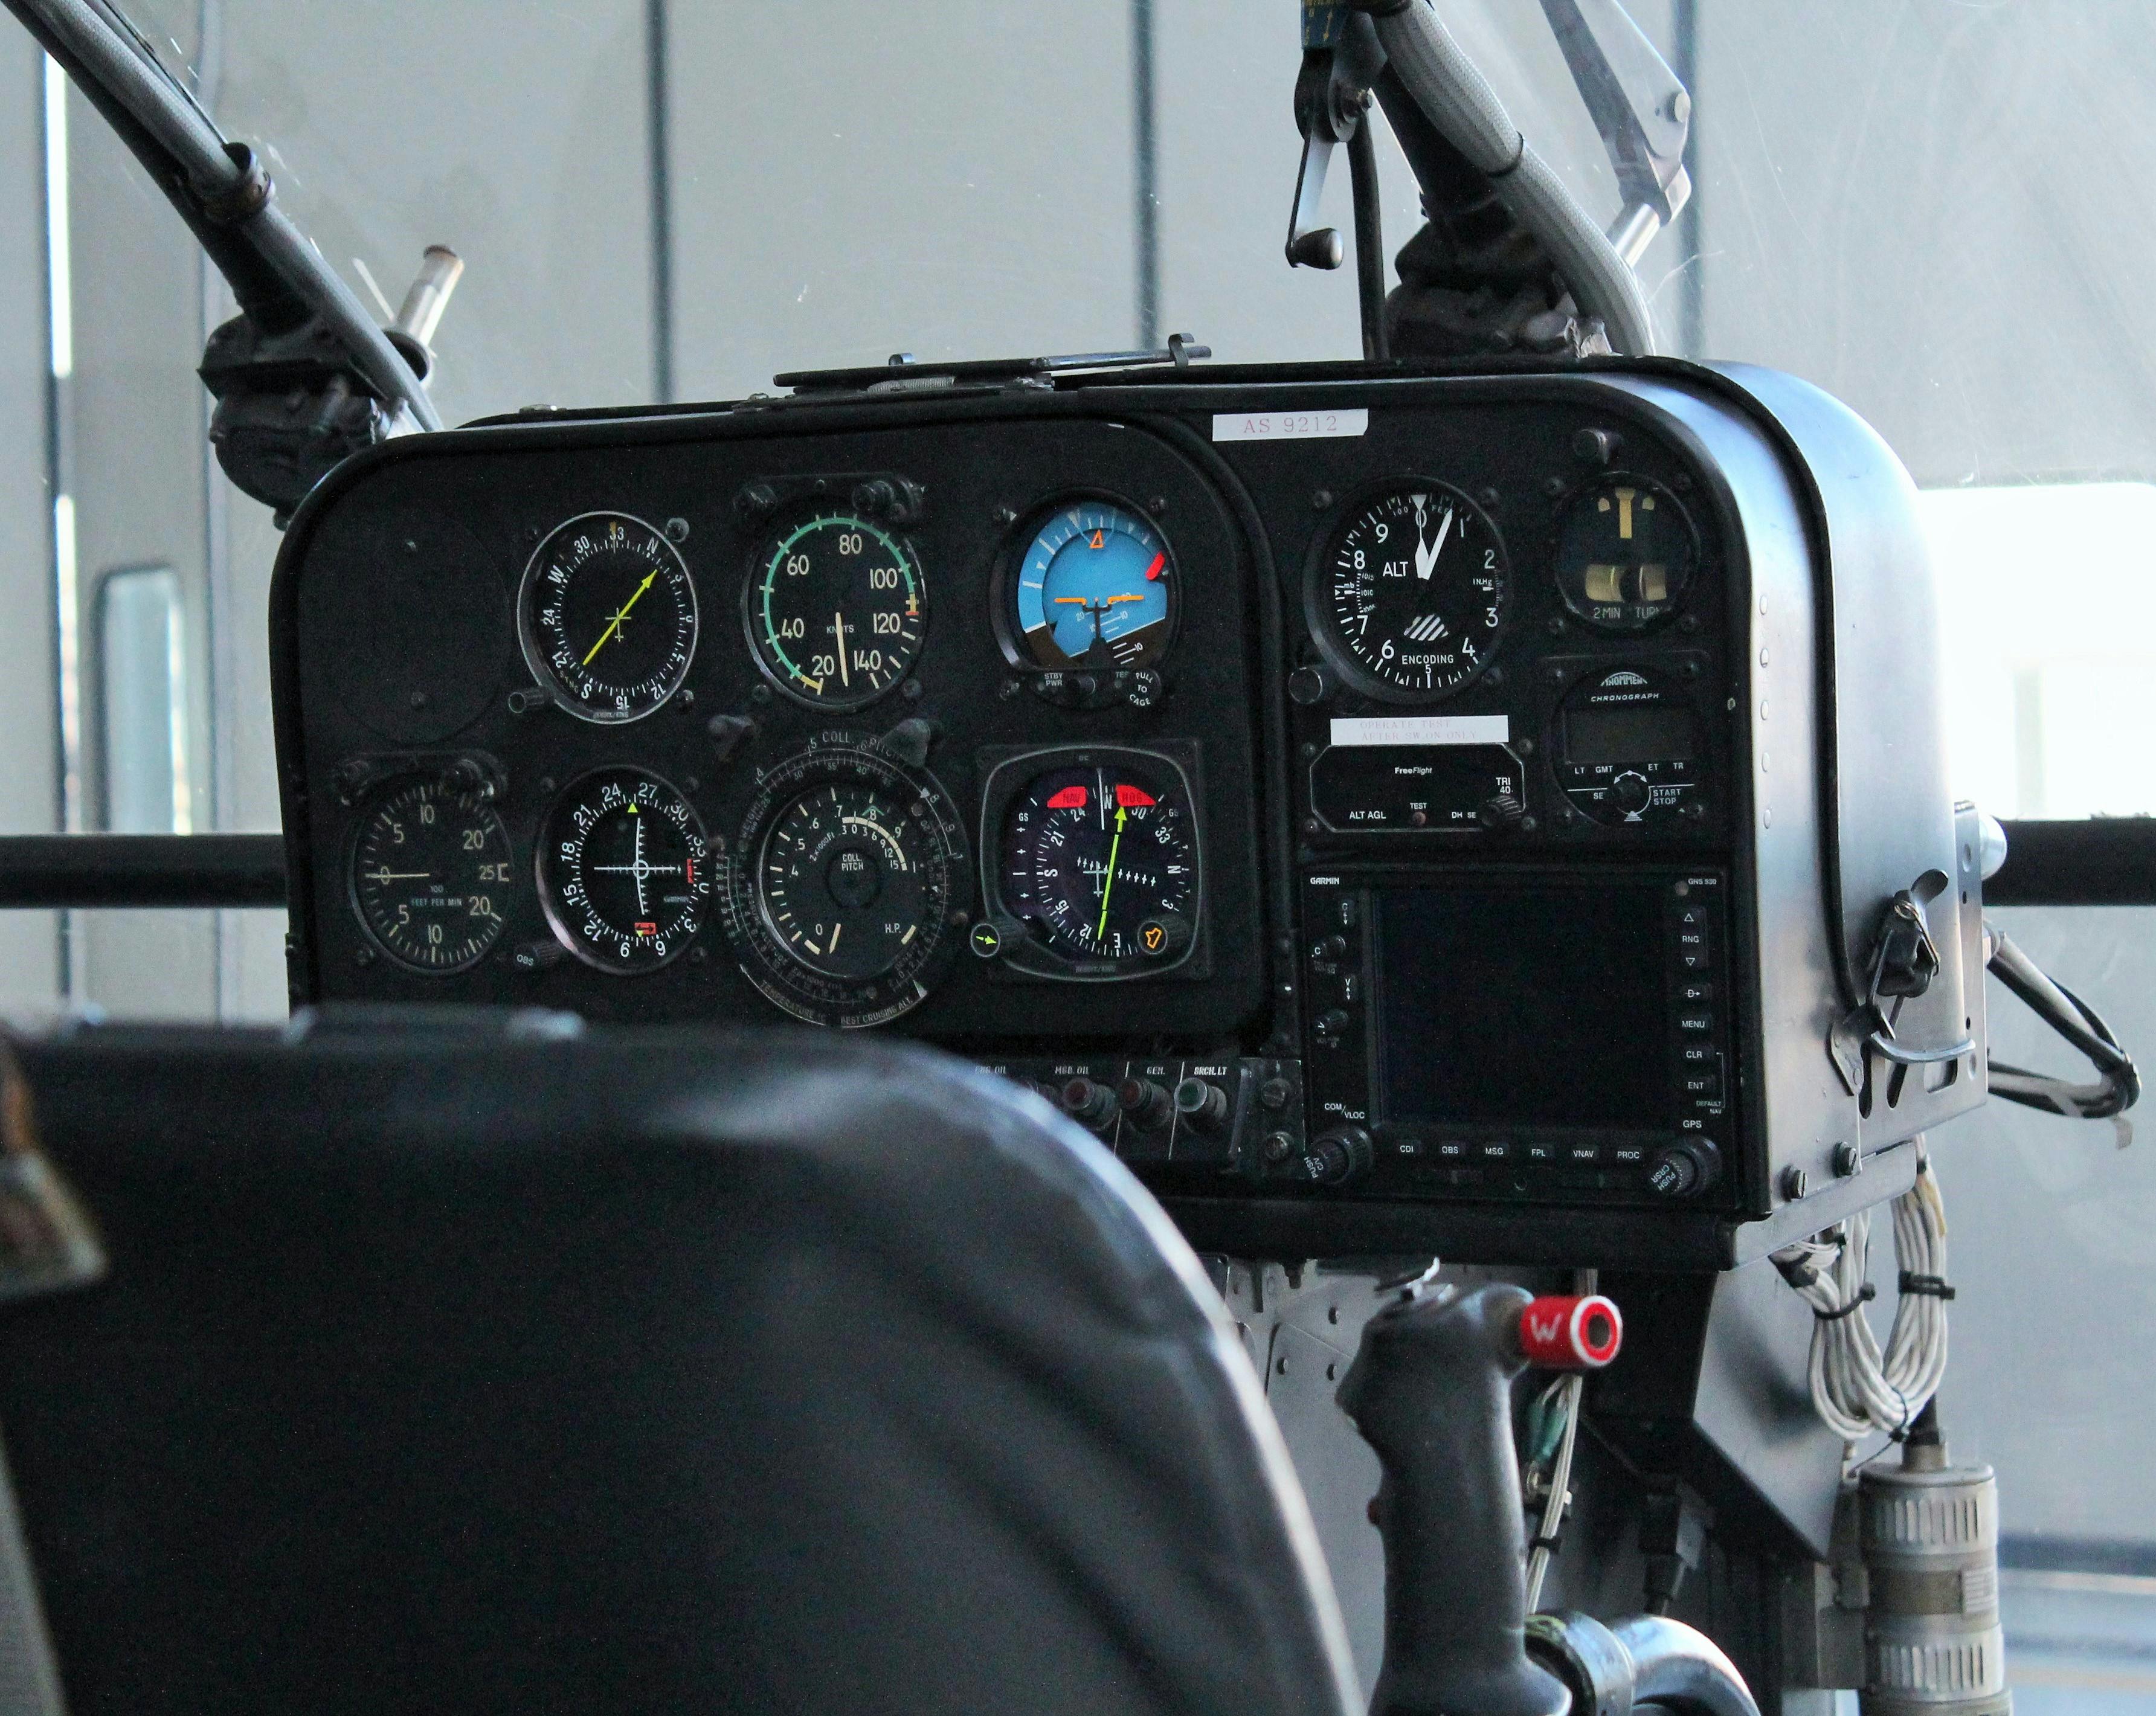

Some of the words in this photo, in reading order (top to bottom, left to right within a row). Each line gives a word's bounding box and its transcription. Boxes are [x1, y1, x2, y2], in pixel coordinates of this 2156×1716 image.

[1243, 419, 1270, 433] AS
[1284, 416, 1337, 432] 9212
[1415, 509, 1427, 528] 0
[1375, 523, 1389, 544] 9
[574, 535, 591, 554] 30
[647, 537, 659, 554] N
[839, 534, 863, 554] 80
[787, 555, 809, 575] 60
[1354, 550, 1365, 570] 8
[1484, 549, 1495, 569] 2
[547, 565, 565, 584] W
[1382, 561, 1409, 577] ALT
[870, 568, 898, 589] 100
[543, 608, 555, 625] 24
[1485, 607, 1499, 628] 3
[1594, 606, 1601, 620] 2
[1602, 606, 1621, 620] MIN
[781, 618, 805, 638] 40
[826, 625, 854, 634] KNTS
[873, 613, 900, 634] 120
[1357, 615, 1368, 635] 7
[1134, 642, 1144, 652] 10
[1381, 639, 1395, 659] 6
[1462, 637, 1475, 657] 4
[812, 655, 835, 676] 20
[854, 650, 881, 670] 140
[1401, 655, 1454, 664] ENCODING
[1425, 665, 1432, 674] 5
[1136, 672, 1154, 684] PULL
[581, 683, 592, 699] S
[651, 684, 666, 700] 12
[1138, 684, 1148, 693] TO
[616, 696, 630, 710] 15
[1130, 694, 1151, 706] CAGE
[1591, 693, 1659, 702] CHRONOGRAPH
[1360, 720, 1414, 729] OPERATE
[1421, 719, 1450, 728] TEST
[810, 737, 817, 749] 5
[822, 730, 855, 744] COLL.
[1362, 732, 1398, 742] AFTER
[1446, 731, 1476, 740] ONLY
[1395, 766, 1432, 776] FreeFlight
[1595, 765, 1613, 774] GMT
[1496, 777, 1511, 786] TRI
[602, 782, 622, 802] 24
[638, 782, 658, 799] 27
[420, 805, 434, 824] 10
[573, 804, 591, 826] 21
[670, 800, 689, 821] 30
[1018, 812, 1029, 822] GS
[1367, 811, 1386, 819] AGL
[394, 824, 404, 844] 5
[851, 824, 858, 834] 0
[862, 827, 868, 837] 3
[871, 831, 877, 841] 6
[1155, 826, 1171, 844] 33
[463, 830, 483, 850] 20
[880, 839, 886, 849] 9
[1050, 831, 1066, 847] 21
[561, 843, 575, 862] 18
[842, 853, 863, 862] COLL.
[884, 848, 893, 858] 12
[479, 865, 494, 880] 25
[841, 862, 864, 871] PITCH
[890, 860, 899, 869] 15
[1167, 865, 1182, 874] N
[380, 866, 390, 885] 0
[1044, 869, 1058, 877] S
[448, 898, 462, 906] MIN
[563, 885, 580, 907] 15
[1162, 898, 1174, 910] 3
[398, 904, 410, 924] 5
[469, 896, 491, 916] 20
[1055, 899, 1070, 915] 15
[428, 924, 442, 943] 10
[584, 920, 603, 942] 12
[684, 918, 697, 933] 3
[816, 924, 823, 936] 0
[885, 923, 901, 934] H.P.
[1079, 923, 1093, 939] 12
[1113, 933, 1122, 948] E
[1314, 946, 1321, 955] C
[516, 954, 534, 966] OBS
[1345, 978, 1351, 986] V
[862, 1005, 898, 1024] CRUISING
[1076, 1066, 1089, 1075] OIL
[1147, 1066, 1166, 1075] GEN.
[1303, 1157, 1319, 1178] PUSH
[1651, 1165, 1670, 1184] CRSR
[1657, 1172, 1677, 1192] PUSH
[1530, 1313, 1563, 1342] W
